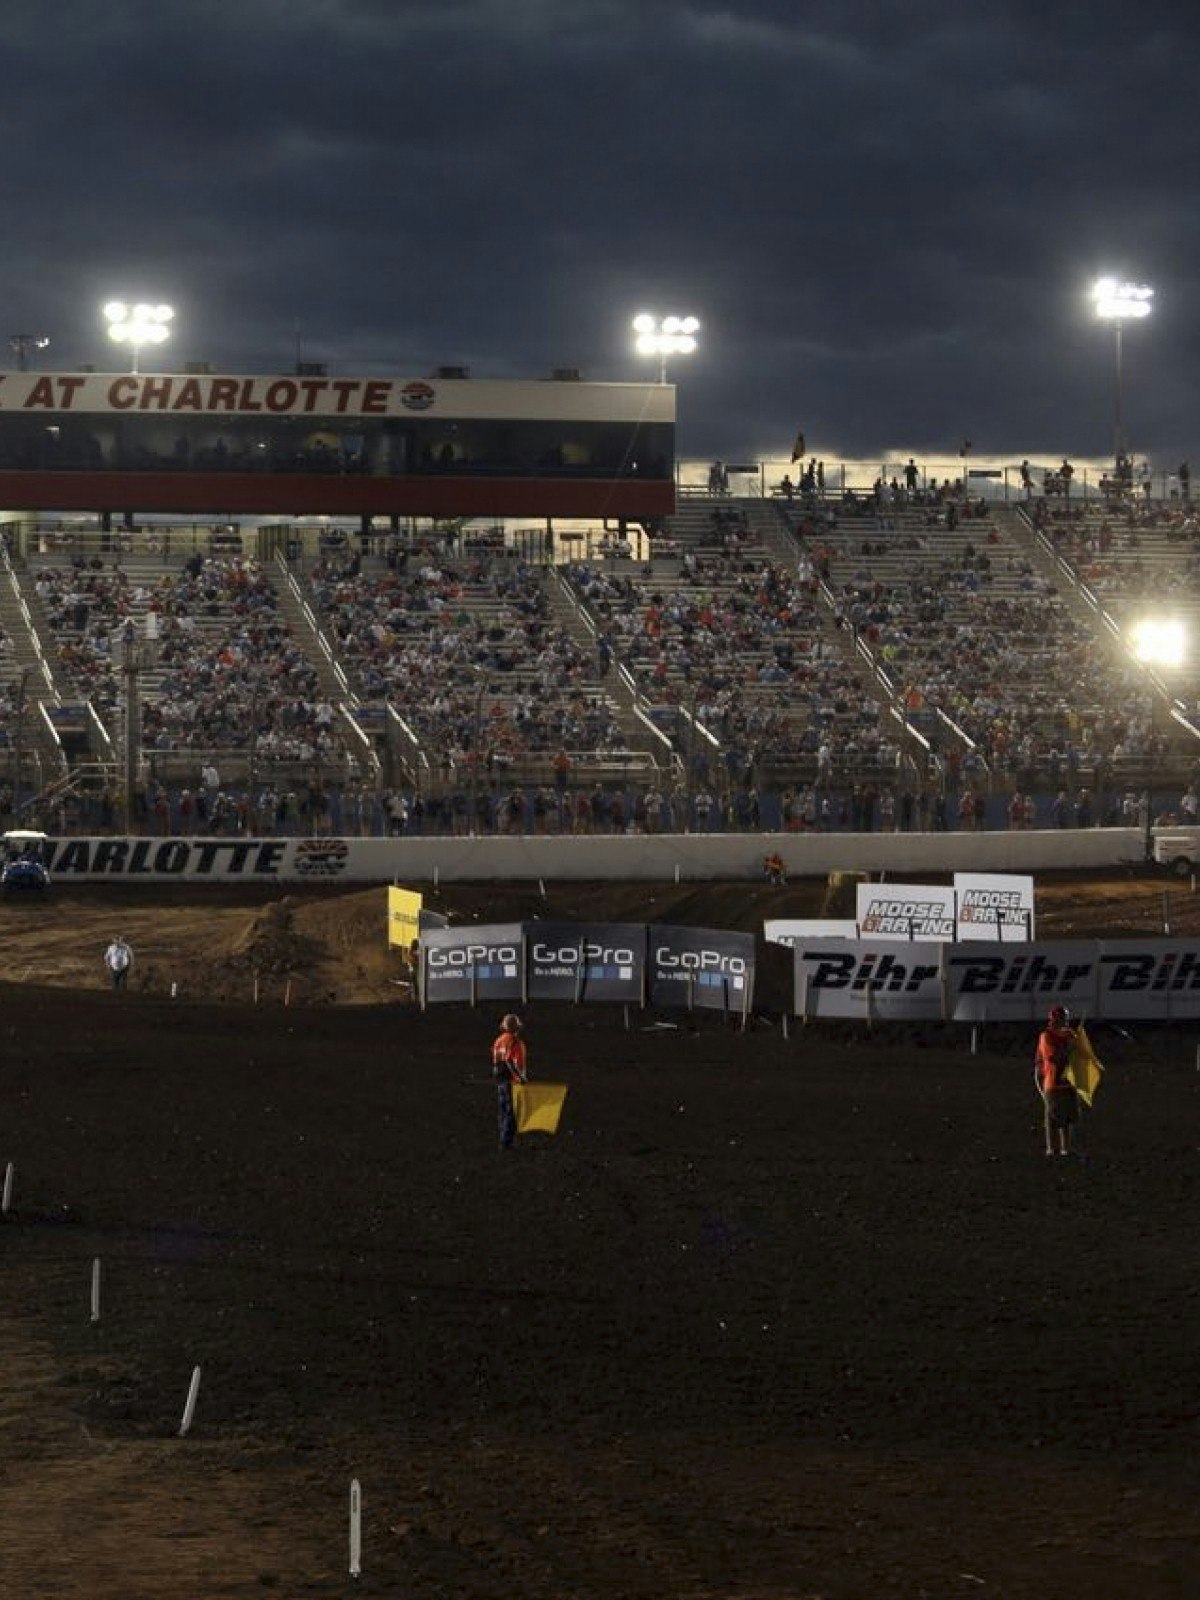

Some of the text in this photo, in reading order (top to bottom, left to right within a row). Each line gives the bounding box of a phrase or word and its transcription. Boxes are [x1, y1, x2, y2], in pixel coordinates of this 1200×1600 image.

[24, 377, 85, 409] AT
[107, 377, 393, 412] CHARLOTTE
[867, 900, 945, 918] MOOSE
[963, 889, 1022, 907] MOOSE
[428, 946, 516, 966] GoPro
[533, 944, 633, 963] GoPro
[656, 947, 745, 973] GoPro
[803, 952, 938, 991] Bihr
[951, 956, 1090, 993] Bihr
[1100, 951, 1200, 991] Bih
